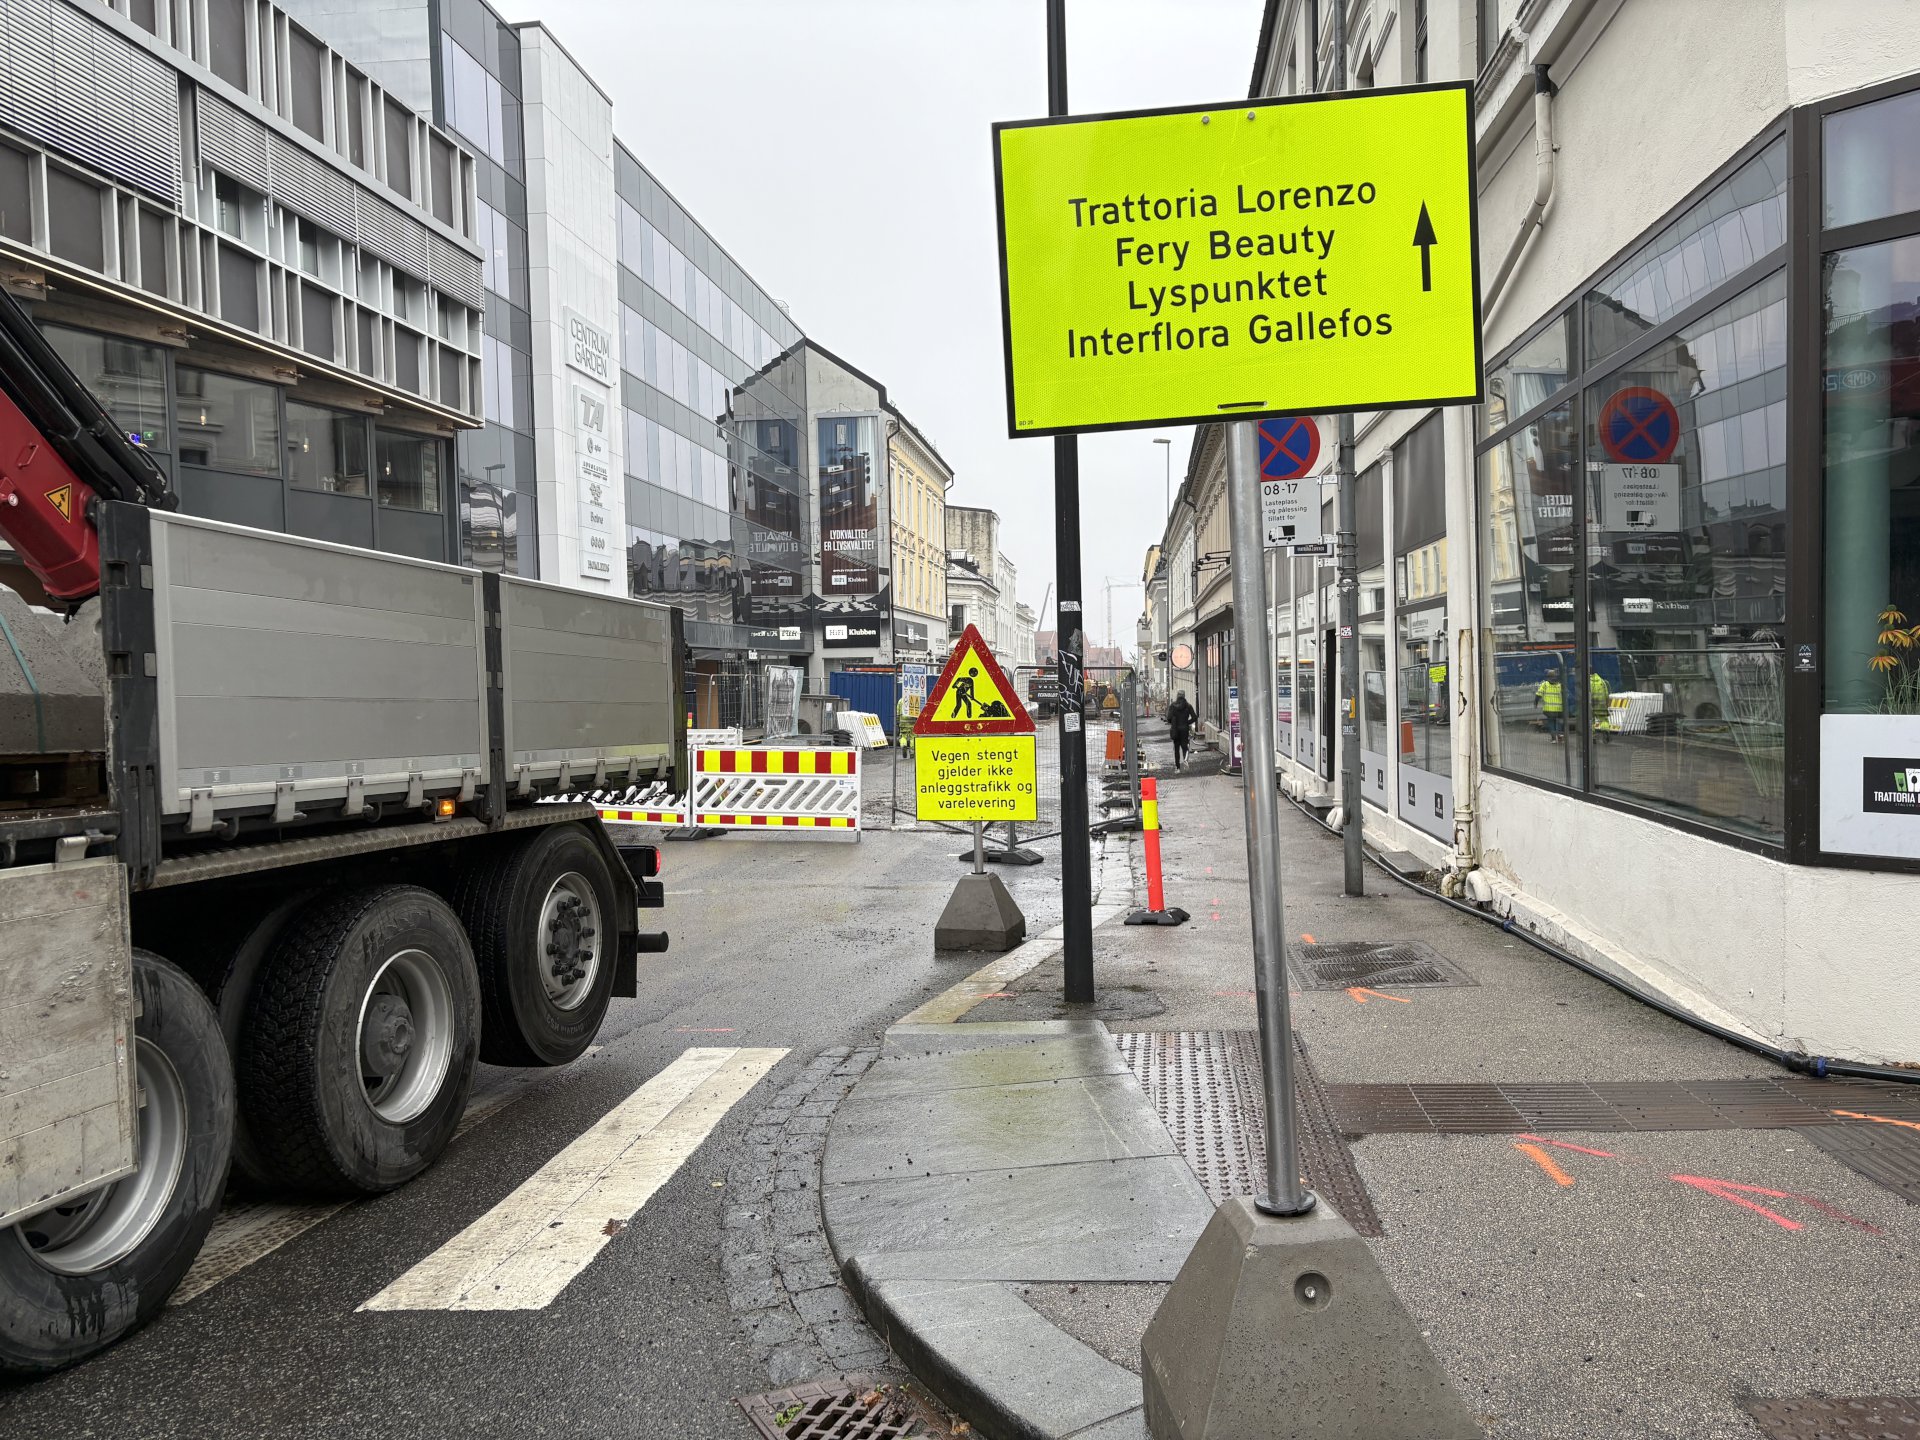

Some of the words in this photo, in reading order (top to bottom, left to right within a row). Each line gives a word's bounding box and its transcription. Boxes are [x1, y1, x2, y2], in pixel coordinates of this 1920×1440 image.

[1068, 188, 1218, 227] Trattoria
[1237, 182, 1376, 214] Lorenzo
[1117, 237, 1190, 271] Fery
[1210, 224, 1335, 260] Beauty
[1129, 267, 1328, 317] Lyspunktet
[571, 318, 610, 359] CENTRUM
[1068, 322, 1229, 358] Interflora
[1249, 308, 1393, 344] Gallefos
[580, 393, 605, 432] TA
[1265, 499, 1298, 507] Lasteplass
[1268, 514, 1285, 522] tillatt
[829, 528, 868, 540] LYDKVALITET
[824, 541, 832, 551] ER
[832, 540, 874, 551] LIVSKVALITET
[848, 628, 877, 636] Klubben
[931, 750, 970, 763] Vegen
[977, 749, 1019, 762] stengt
[938, 766, 982, 780] gjelder
[987, 764, 1013, 776] ikke
[920, 780, 1011, 795] anleggstrafikk
[1017, 782, 1033, 794] og
[938, 797, 1016, 811] varelevering
[1873, 791, 1916, 804] TRATTORIA
